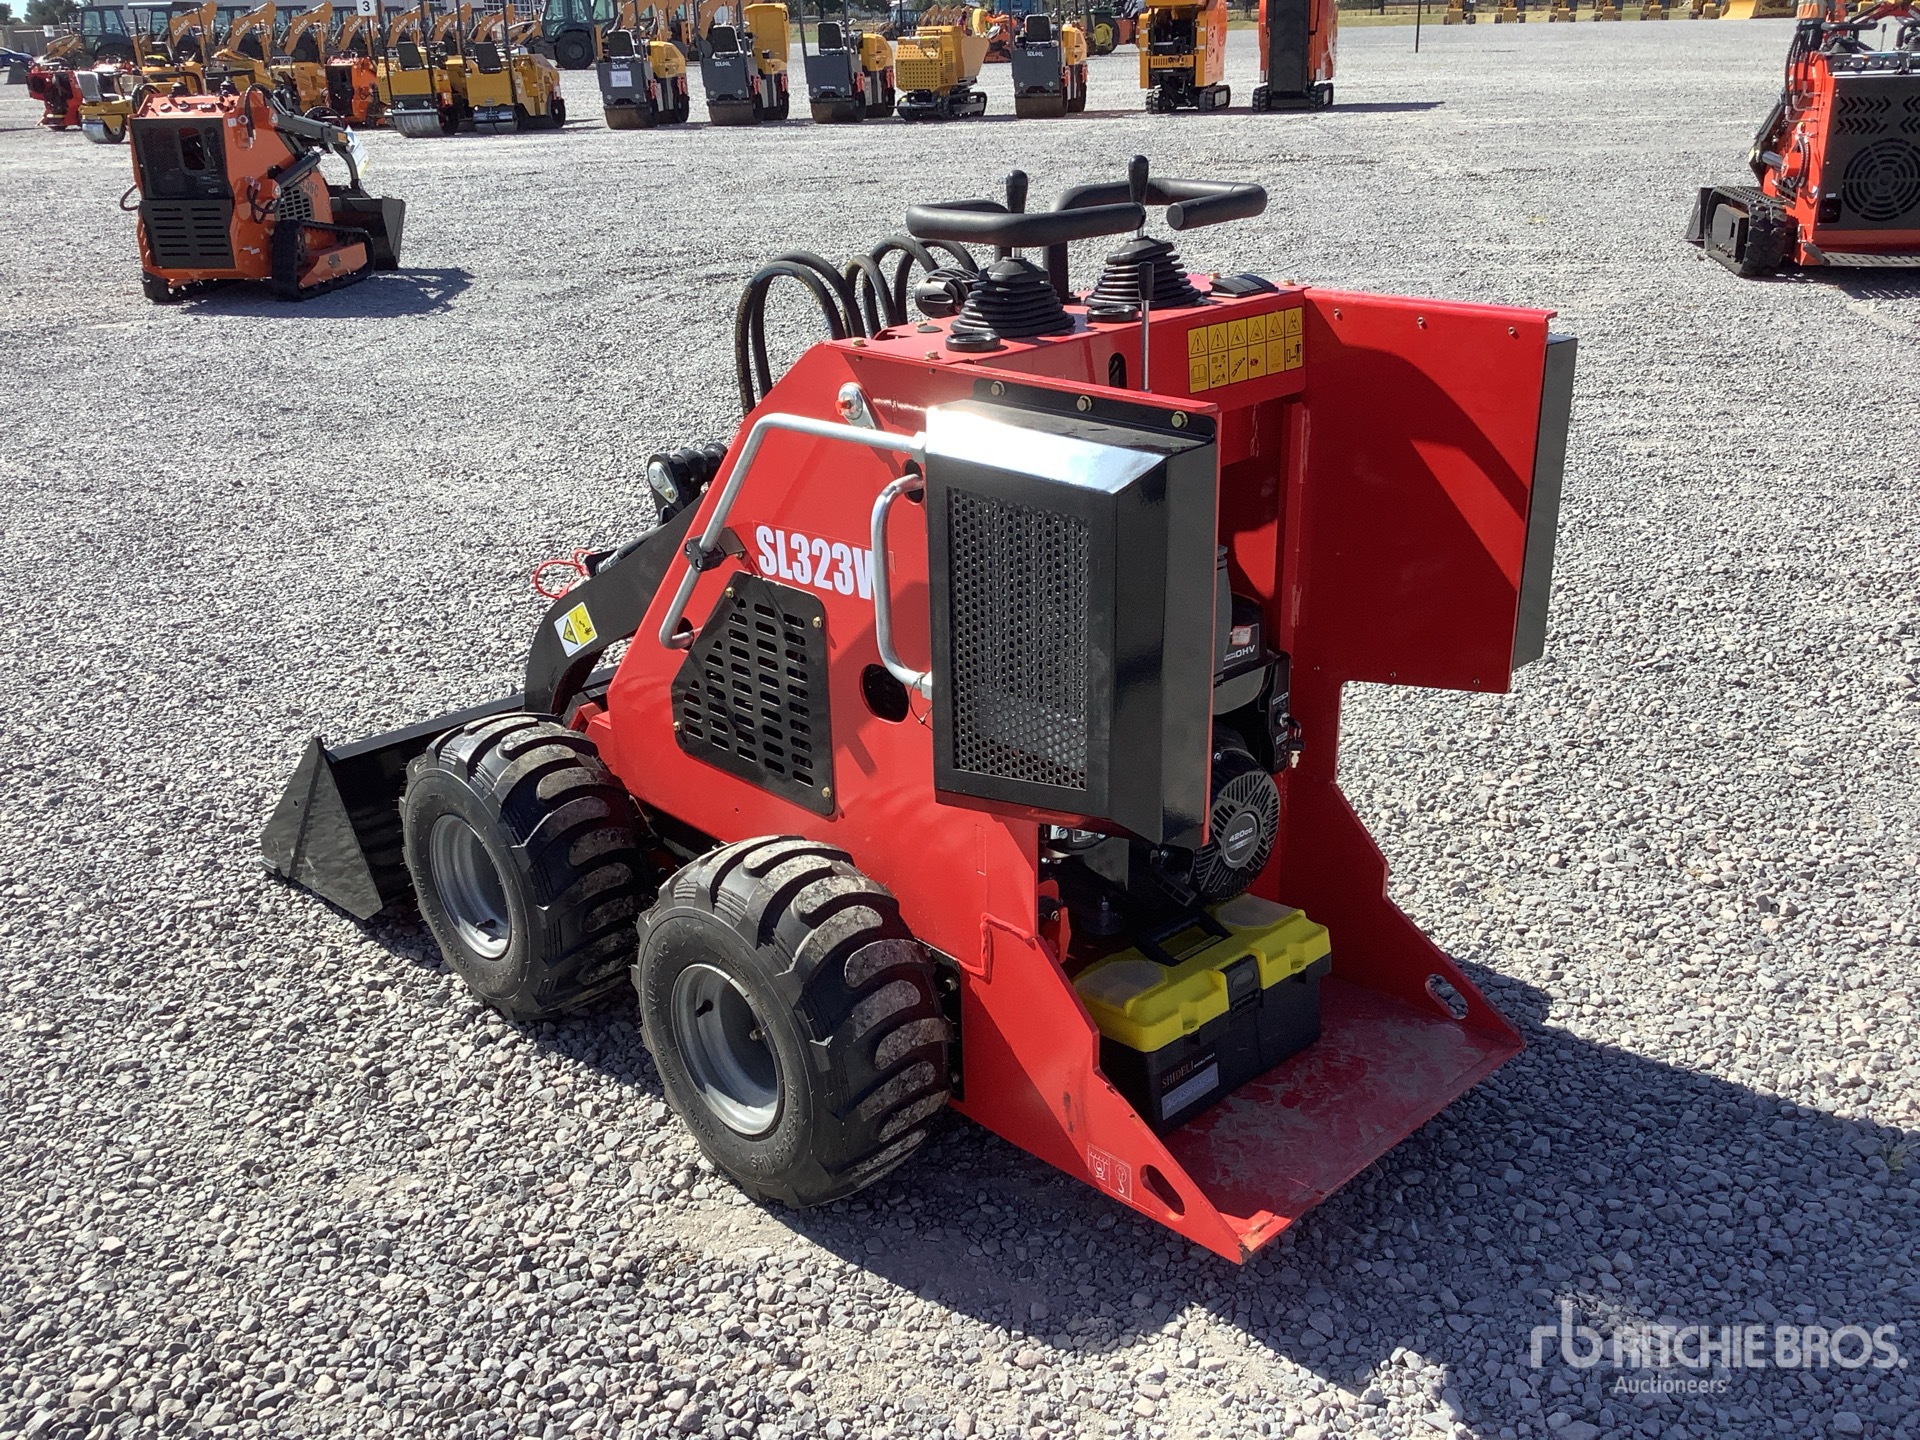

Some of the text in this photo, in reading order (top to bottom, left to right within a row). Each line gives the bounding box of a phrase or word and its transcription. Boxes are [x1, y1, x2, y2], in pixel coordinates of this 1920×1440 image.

[362, 1, 371, 12] 3
[174, 19, 190, 36] CASE
[235, 20, 250, 36] CASE
[294, 19, 309, 35] CASE
[349, 17, 362, 32] CASE
[395, 18, 408, 33] CASE
[440, 18, 452, 32] CASE
[483, 18, 496, 32] CASE
[1235, 645, 1256, 658] OHV
[1229, 827, 1253, 842] 420cc
